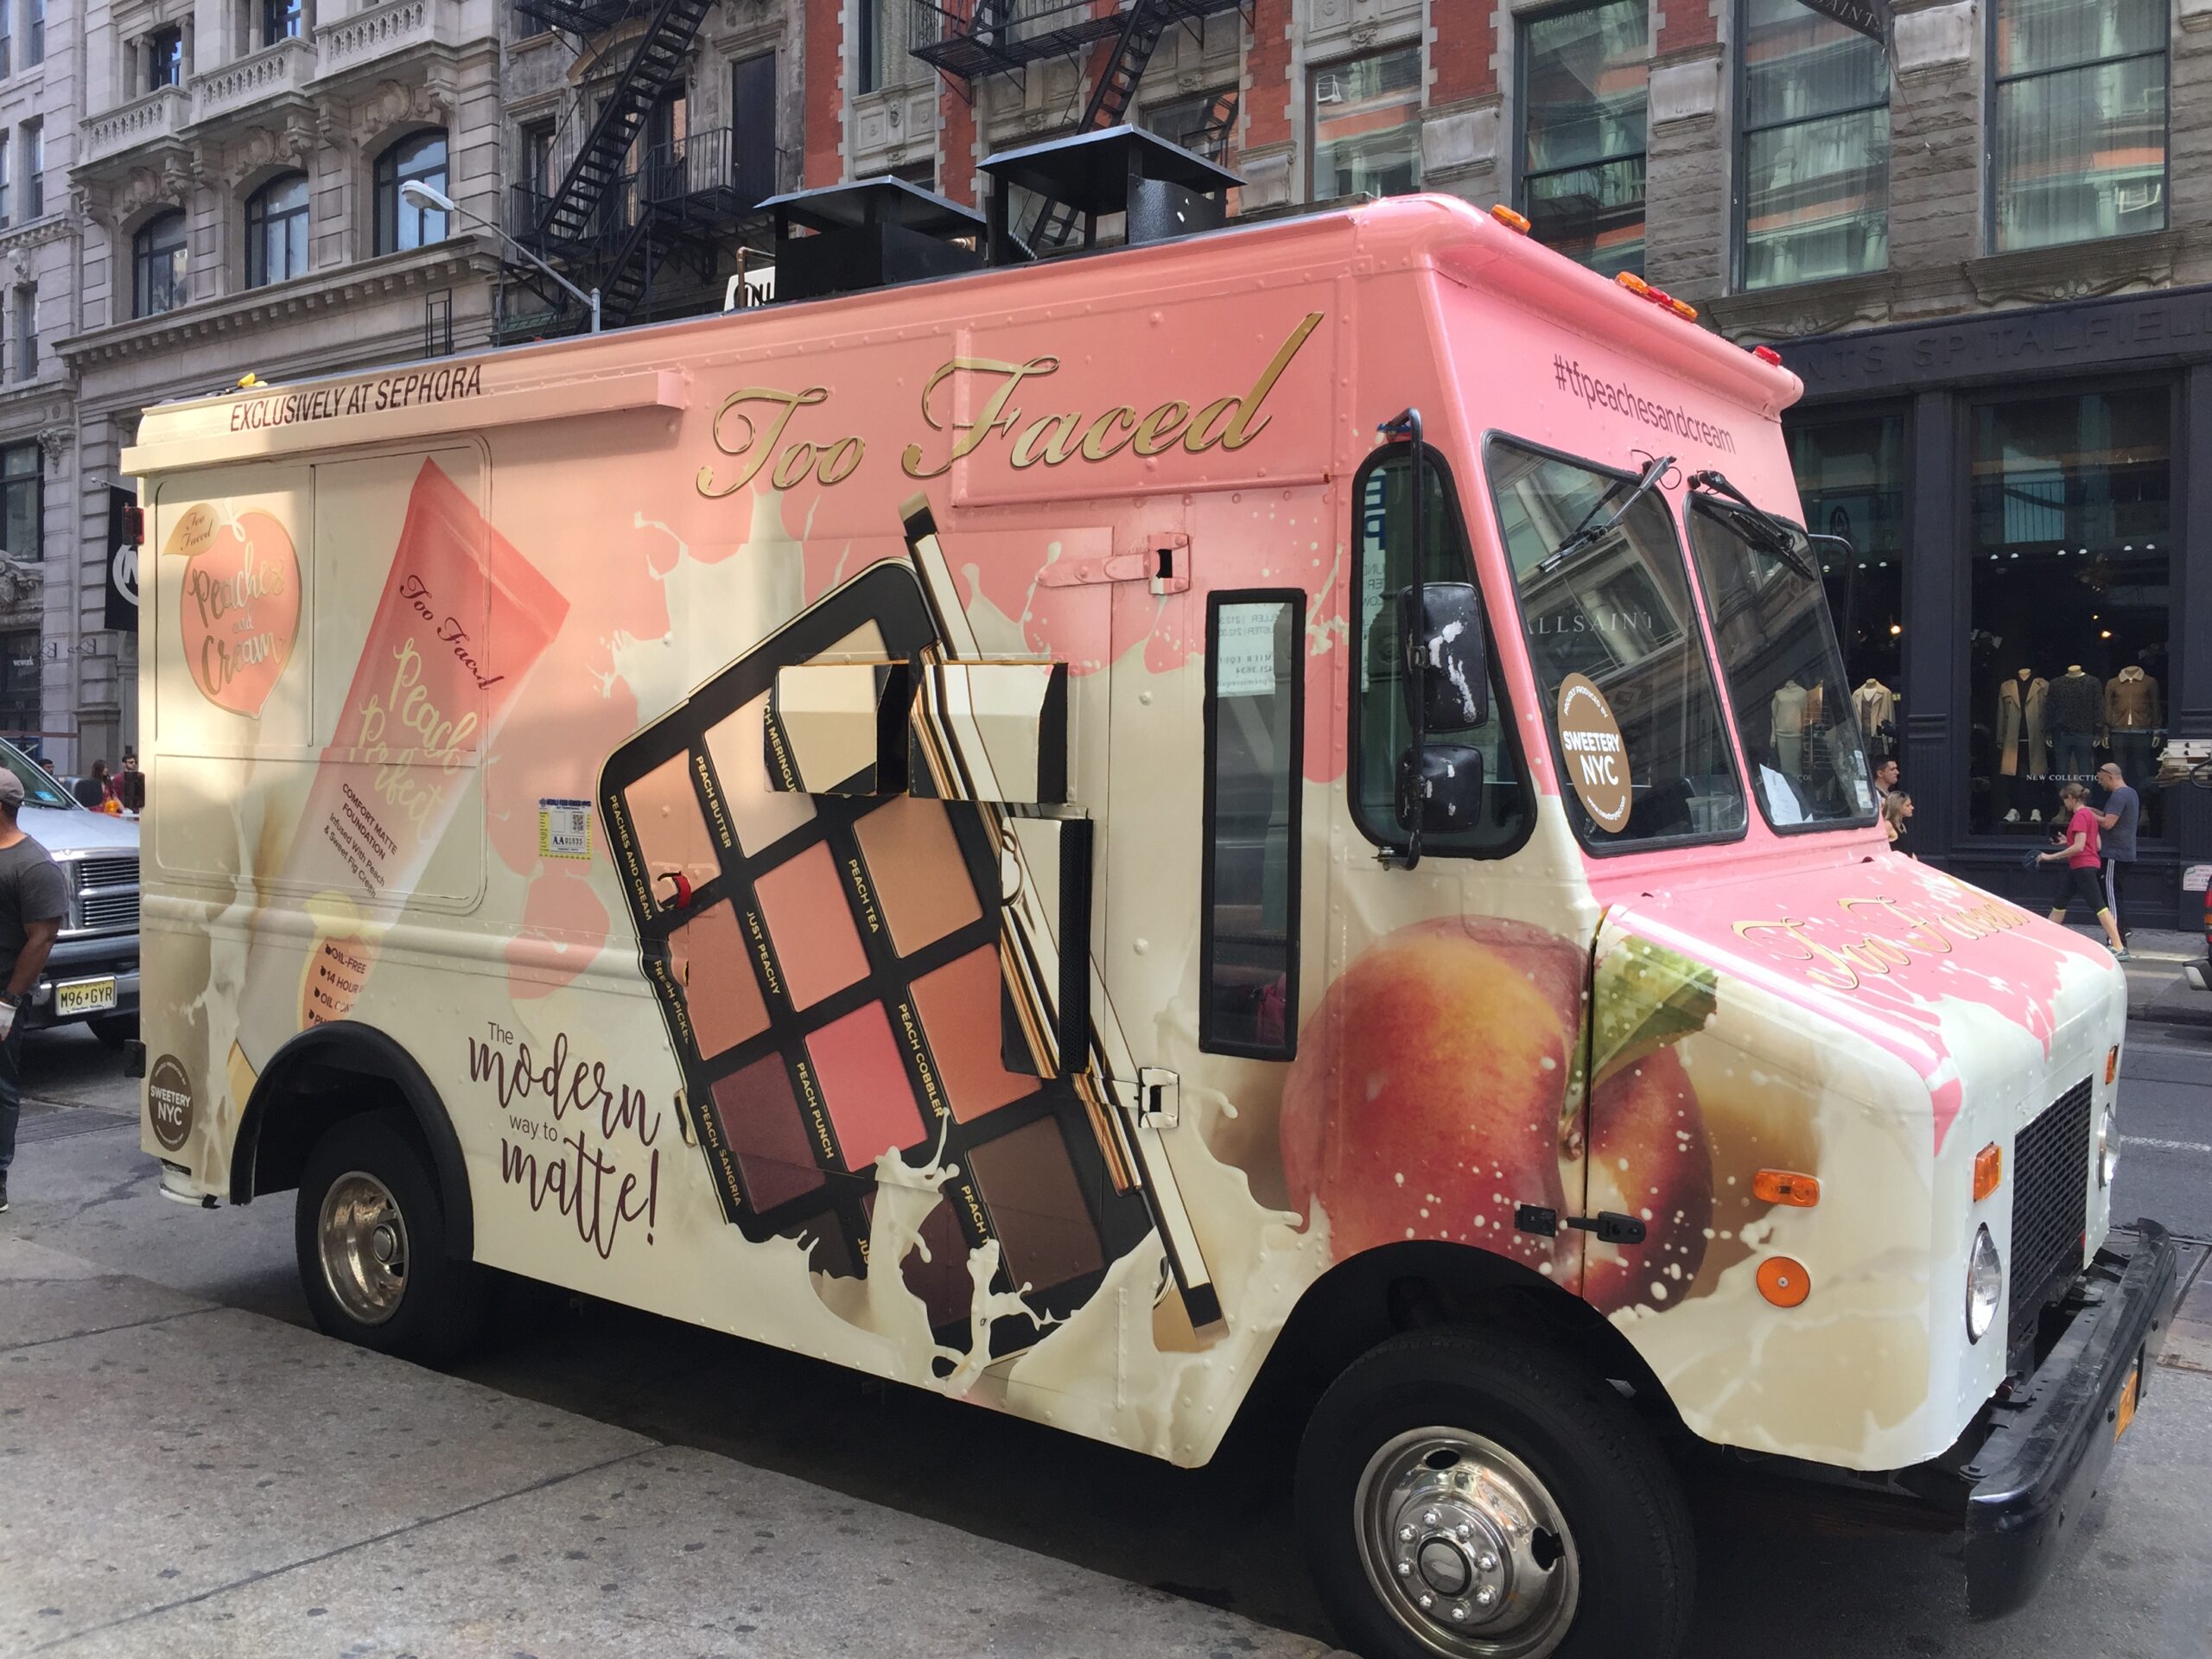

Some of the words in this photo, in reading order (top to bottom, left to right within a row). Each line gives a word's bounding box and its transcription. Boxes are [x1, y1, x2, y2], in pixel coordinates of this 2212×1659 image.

[230, 385, 346, 432] EXCLUSIVELY
[346, 383, 374, 416] AT
[375, 365, 482, 410] SEPHORA
[696, 385, 866, 499] Too
[900, 310, 1325, 480] Faced
[1554, 353, 1736, 454] #tfpeachesandcream
[399, 575, 433, 620] Too
[1562, 731, 1620, 752] SWEETERY
[1580, 754, 1619, 785] NYC
[342, 783, 376, 826] COMFORT
[374, 823, 398, 855] MATTE
[342, 803, 386, 861] FOUNDATION
[696, 755, 715, 804] PEACH
[710, 800, 732, 849] BUTTER
[329, 812, 353, 844] Infused
[352, 840, 367, 863] With
[365, 860, 385, 887] Peach
[329, 831, 349, 859] Sweet
[347, 855, 359, 874] Fig
[610, 795, 631, 850] PEACHES
[625, 849, 639, 878] AND
[635, 879, 653, 922] CREAM
[849, 858, 870, 905] PEACH
[865, 906, 880, 933] TEA
[327, 970, 336, 984] 14
[336, 976, 359, 994] HOUR
[332, 947, 367, 975] OIL-FREE
[747, 911, 763, 941] JUST
[758, 944, 781, 995] PEACHY
[61, 991, 83, 1008] M96
[91, 987, 112, 1003] GYR
[321, 993, 334, 1008] OIL
[487, 1021, 514, 1045] The
[898, 1003, 921, 1052] PEACH
[916, 1052, 944, 1118] COBBLER
[150, 1084, 191, 1108] SWEETERY
[157, 1101, 183, 1126] NYC
[468, 1032, 661, 1147] modern
[797, 1062, 818, 1107] PEACH
[812, 1108, 834, 1159] PUNCH
[509, 1115, 539, 1141] way
[543, 1122, 558, 1141] to
[700, 1104, 719, 1149] PEACH
[718, 1149, 742, 1207] SANGRIA
[501, 1129, 659, 1260] matte!
